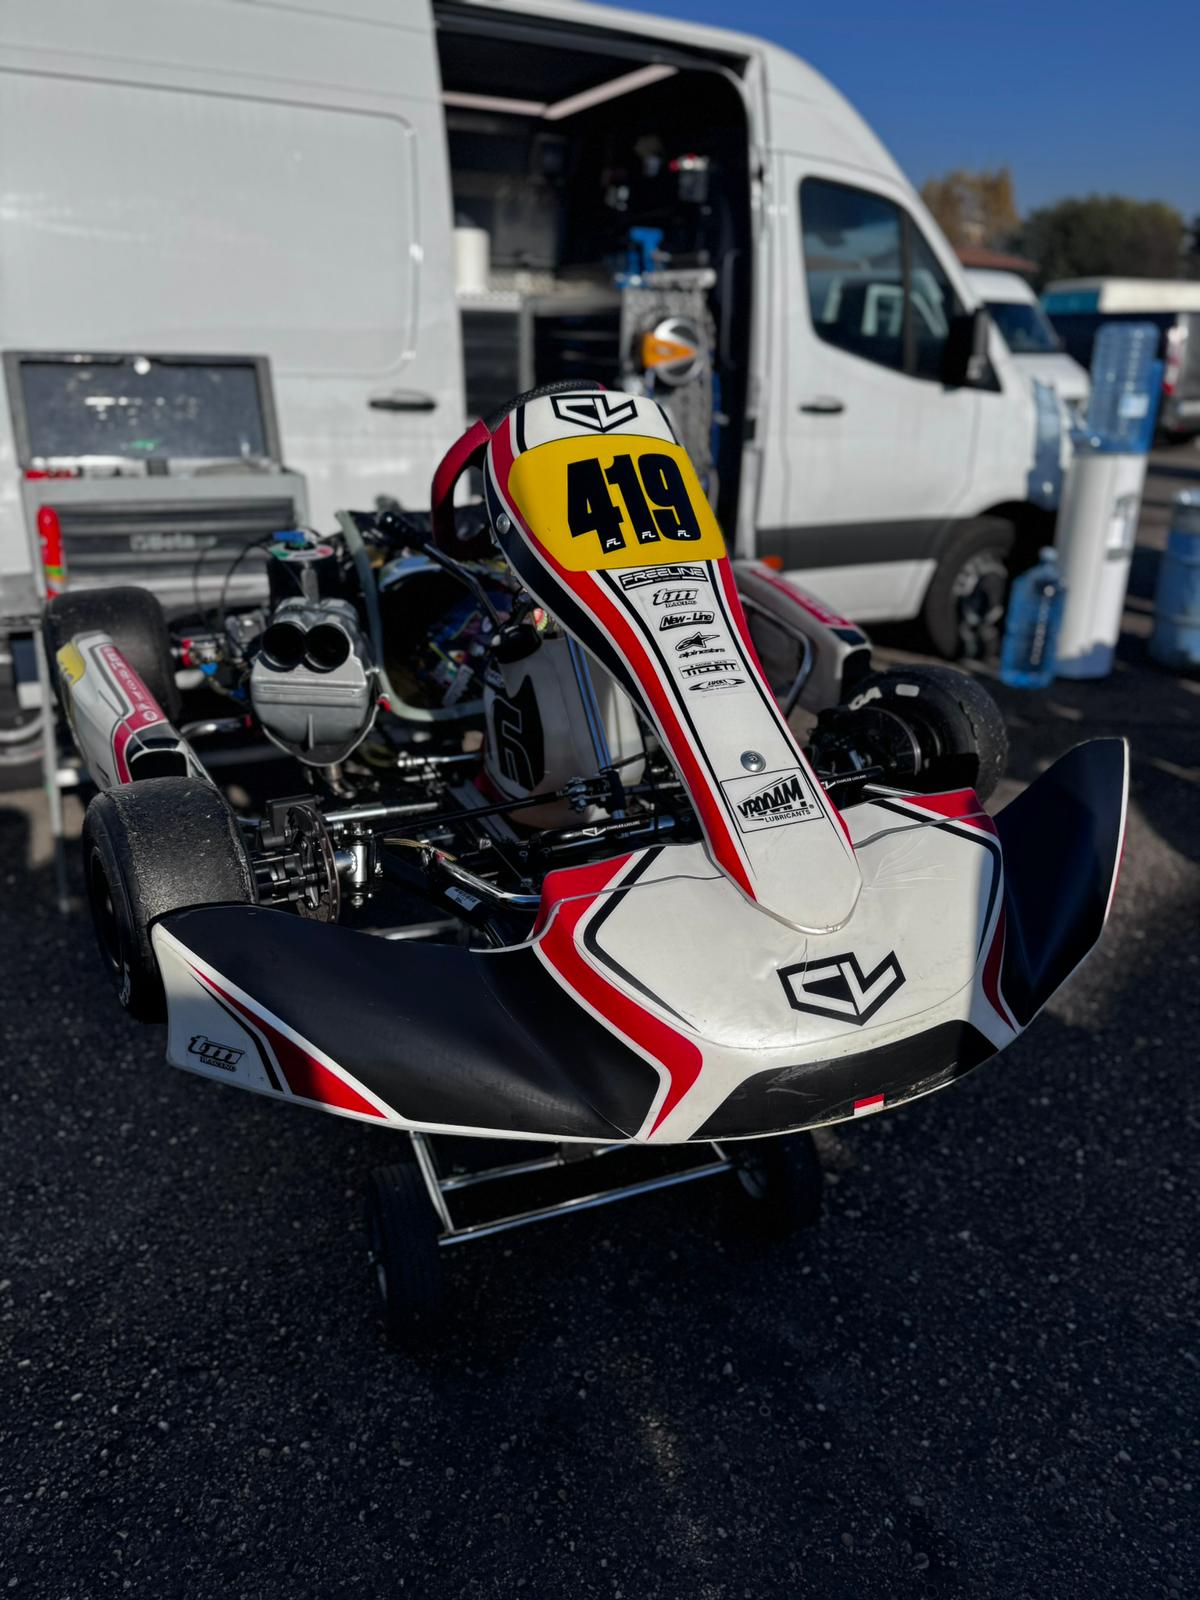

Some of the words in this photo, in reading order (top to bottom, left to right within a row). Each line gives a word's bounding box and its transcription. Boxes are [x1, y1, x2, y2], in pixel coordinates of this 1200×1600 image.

[567, 453, 701, 555] 419
[621, 567, 705, 585] FREELINE
[681, 663, 737, 676] TILLETT
[764, 809, 811, 823] LUBRICANTS
